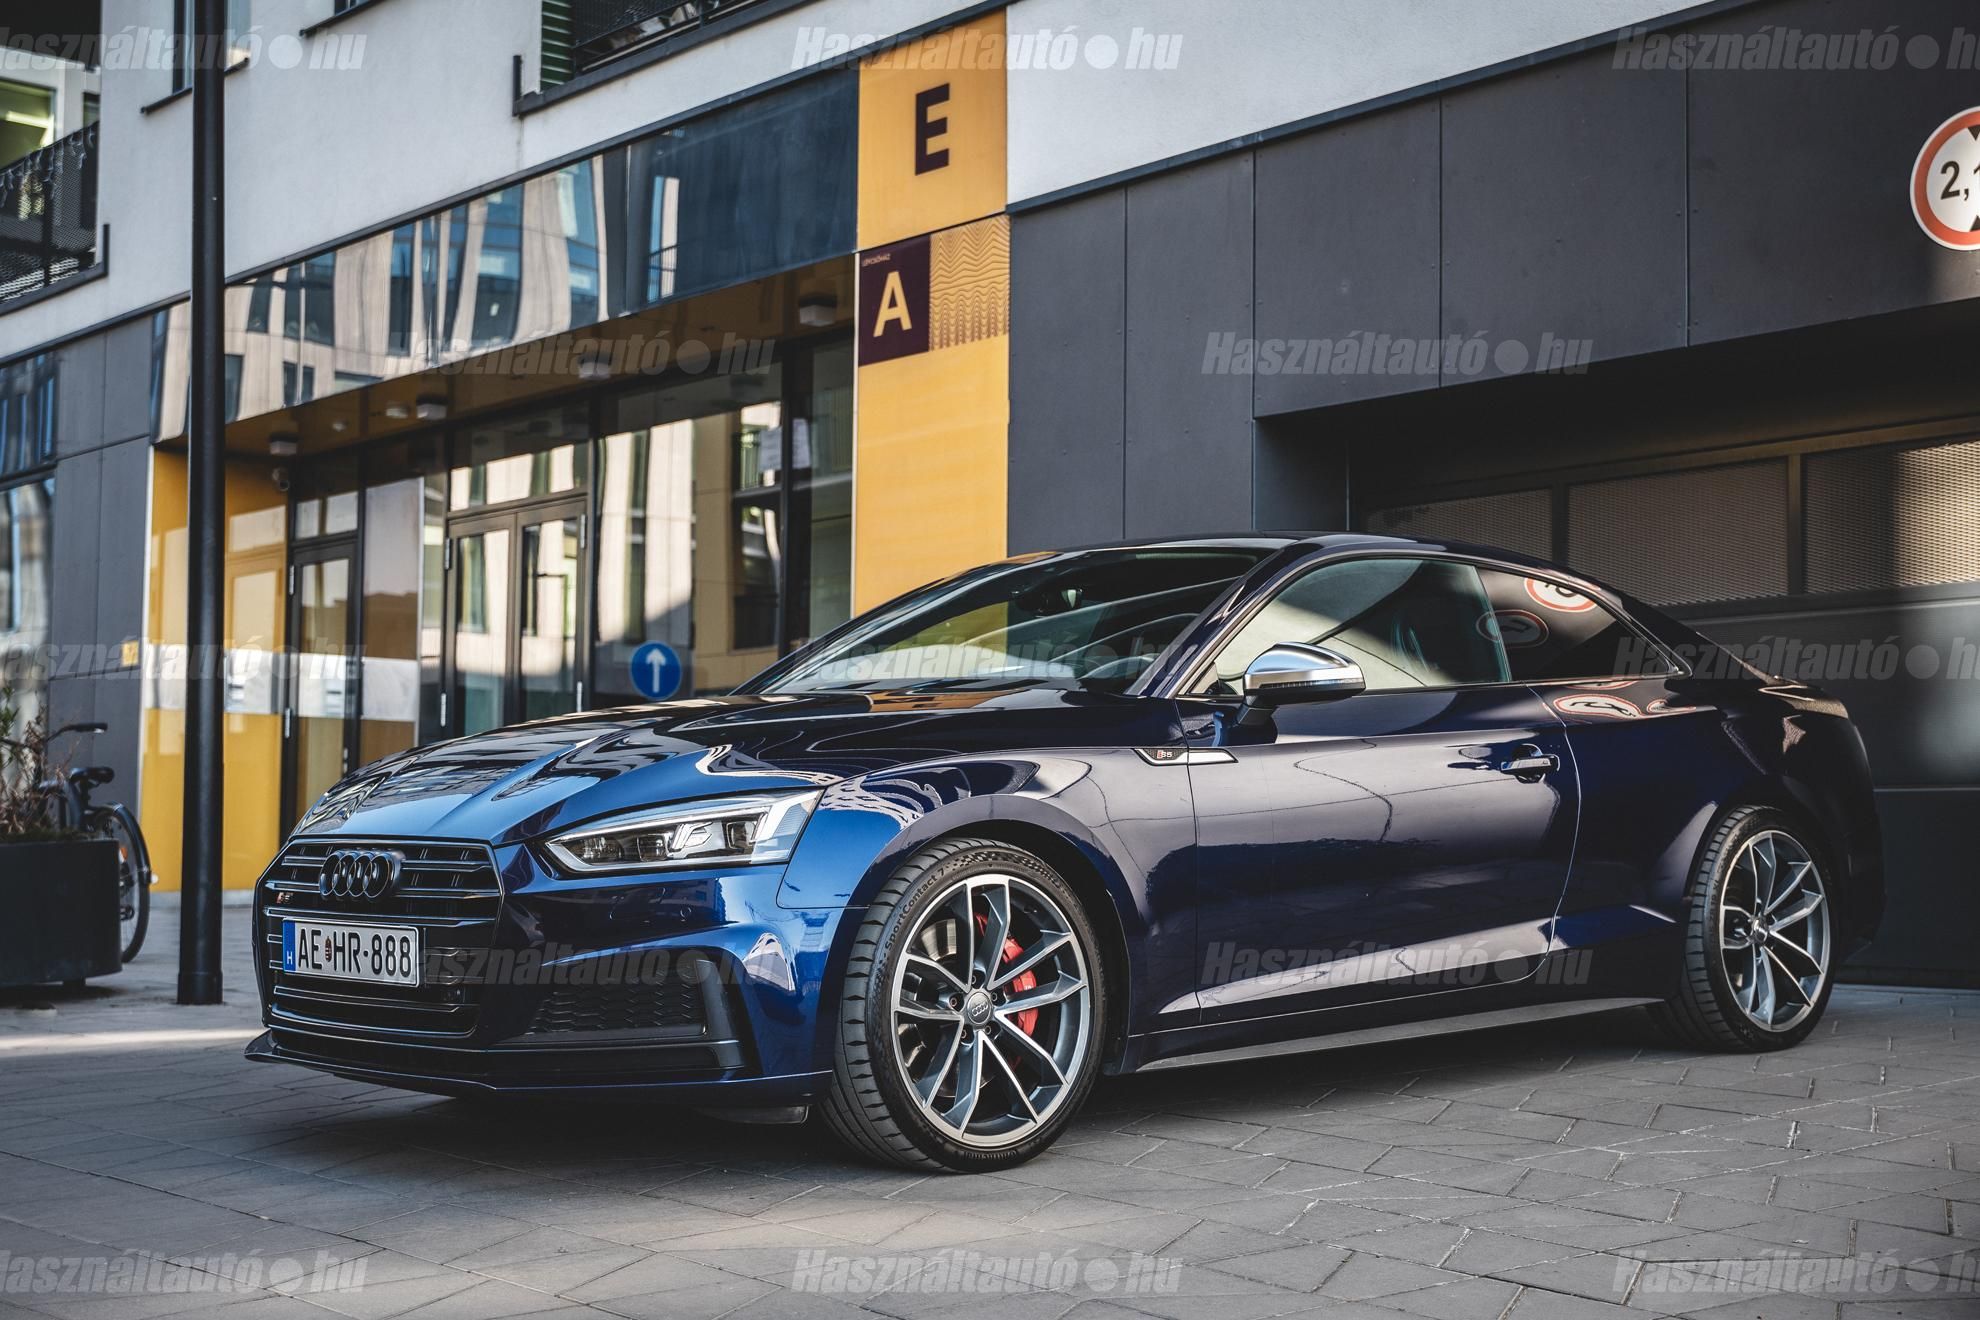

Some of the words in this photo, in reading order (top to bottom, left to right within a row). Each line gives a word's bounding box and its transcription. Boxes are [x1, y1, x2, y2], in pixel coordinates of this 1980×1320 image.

[914, 83, 951, 176] E
[873, 270, 912, 338] A
[885, 874, 937, 952] SportContact
[937, 867, 945, 876] 7
[286, 950, 293, 965] H
